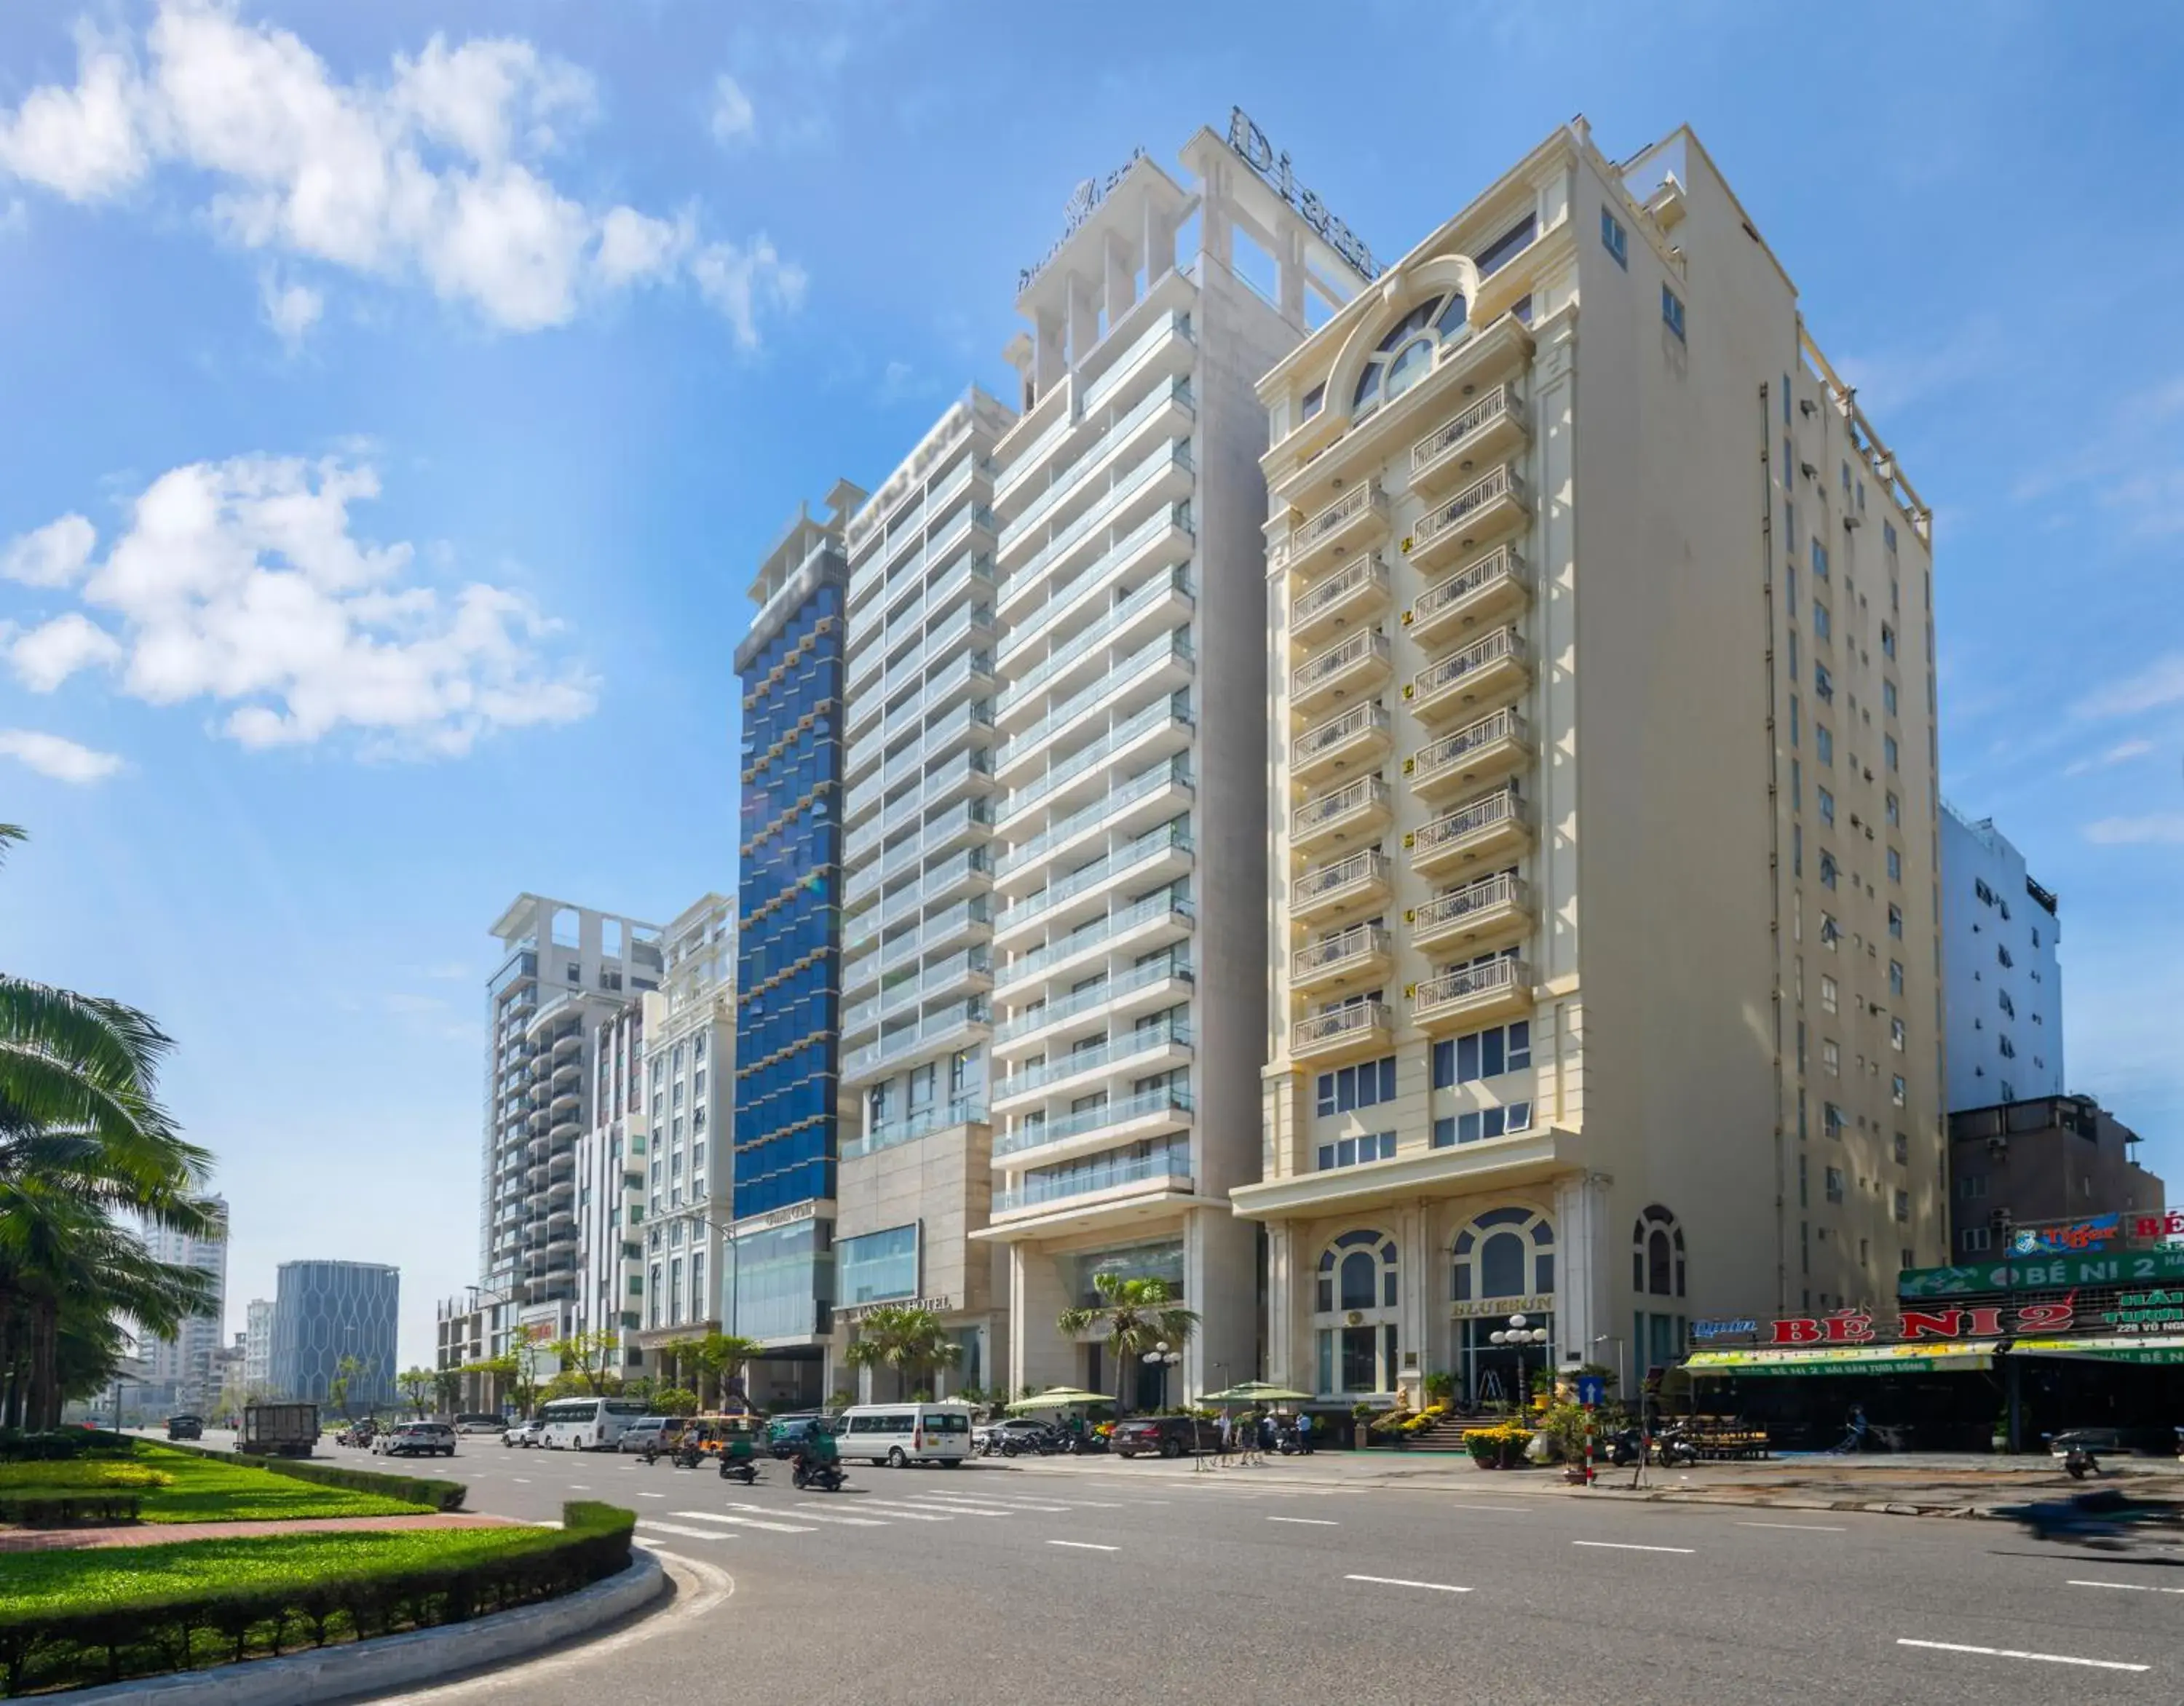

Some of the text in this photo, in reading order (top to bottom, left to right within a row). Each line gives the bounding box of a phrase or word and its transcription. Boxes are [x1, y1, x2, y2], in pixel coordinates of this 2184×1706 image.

[2026, 1258, 2156, 1285] BÉ NI 2
[1770, 1304, 2074, 1344] BÉ NI 2
